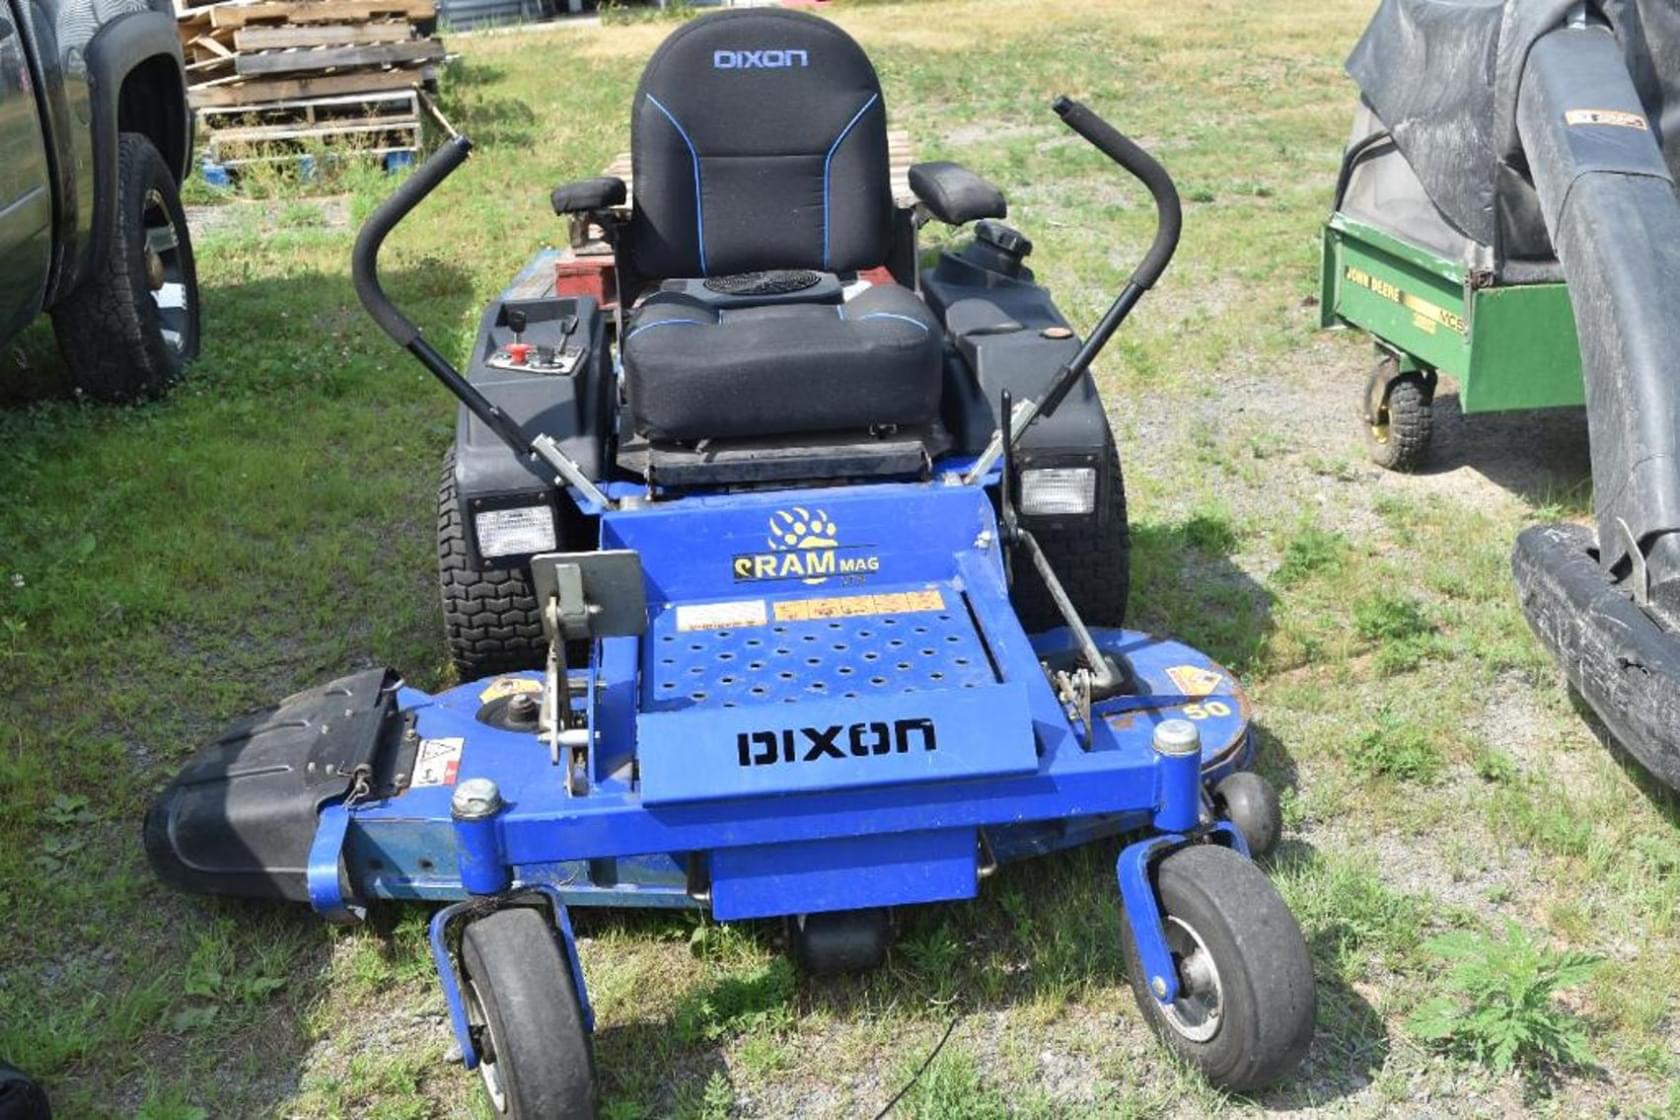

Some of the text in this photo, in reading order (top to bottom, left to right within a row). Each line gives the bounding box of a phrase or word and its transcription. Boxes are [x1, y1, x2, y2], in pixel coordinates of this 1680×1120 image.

[713, 49, 808, 68] DIXON
[839, 556, 880, 572] MAG
[1183, 701, 1232, 719] 50
[737, 718, 937, 766] DIXON
